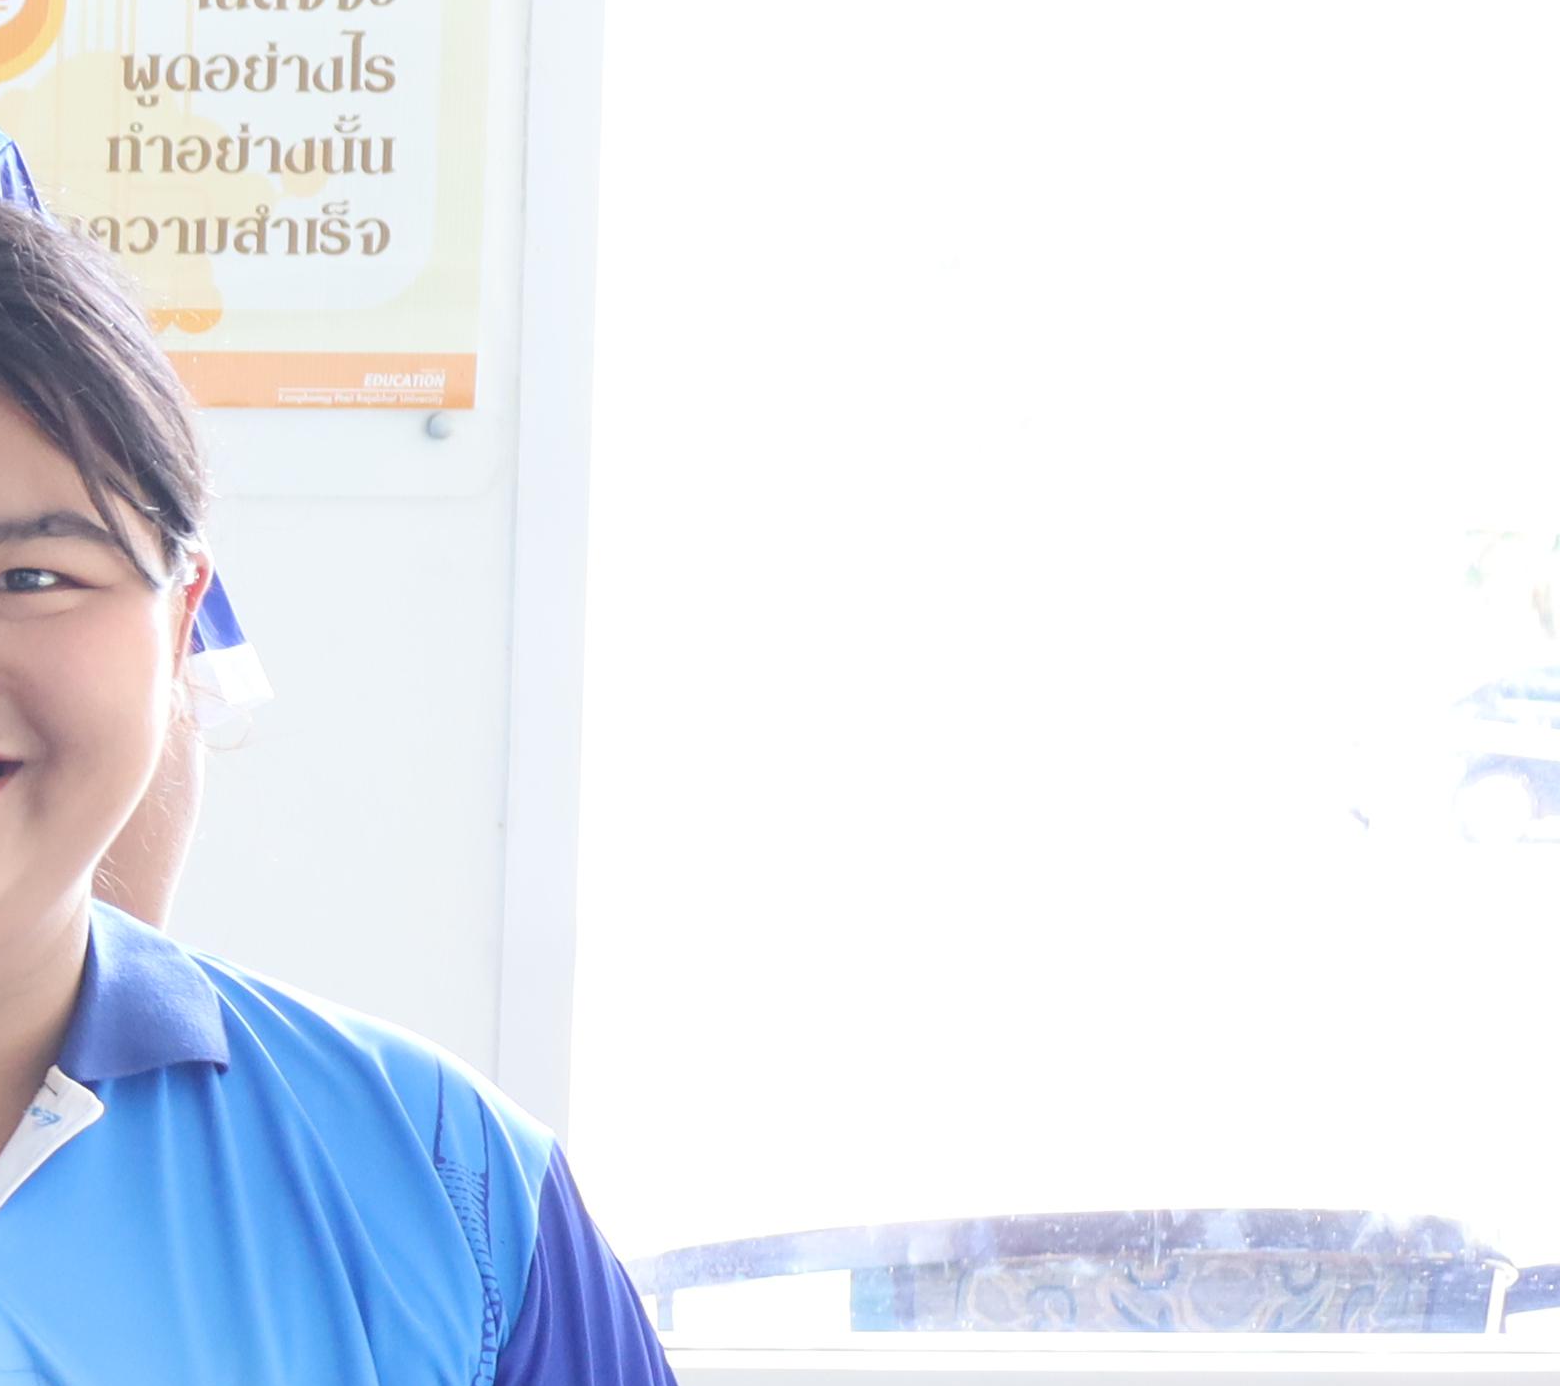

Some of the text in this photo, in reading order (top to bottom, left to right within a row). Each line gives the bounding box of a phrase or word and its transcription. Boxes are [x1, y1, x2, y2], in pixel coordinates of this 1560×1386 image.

[121, 30, 397, 108] พูดอย่างไร
[106, 114, 396, 175] ทำอย่างนั้น
[70, 199, 392, 257] ความสำเร็จ
[364, 372, 446, 388] EDUCATION
